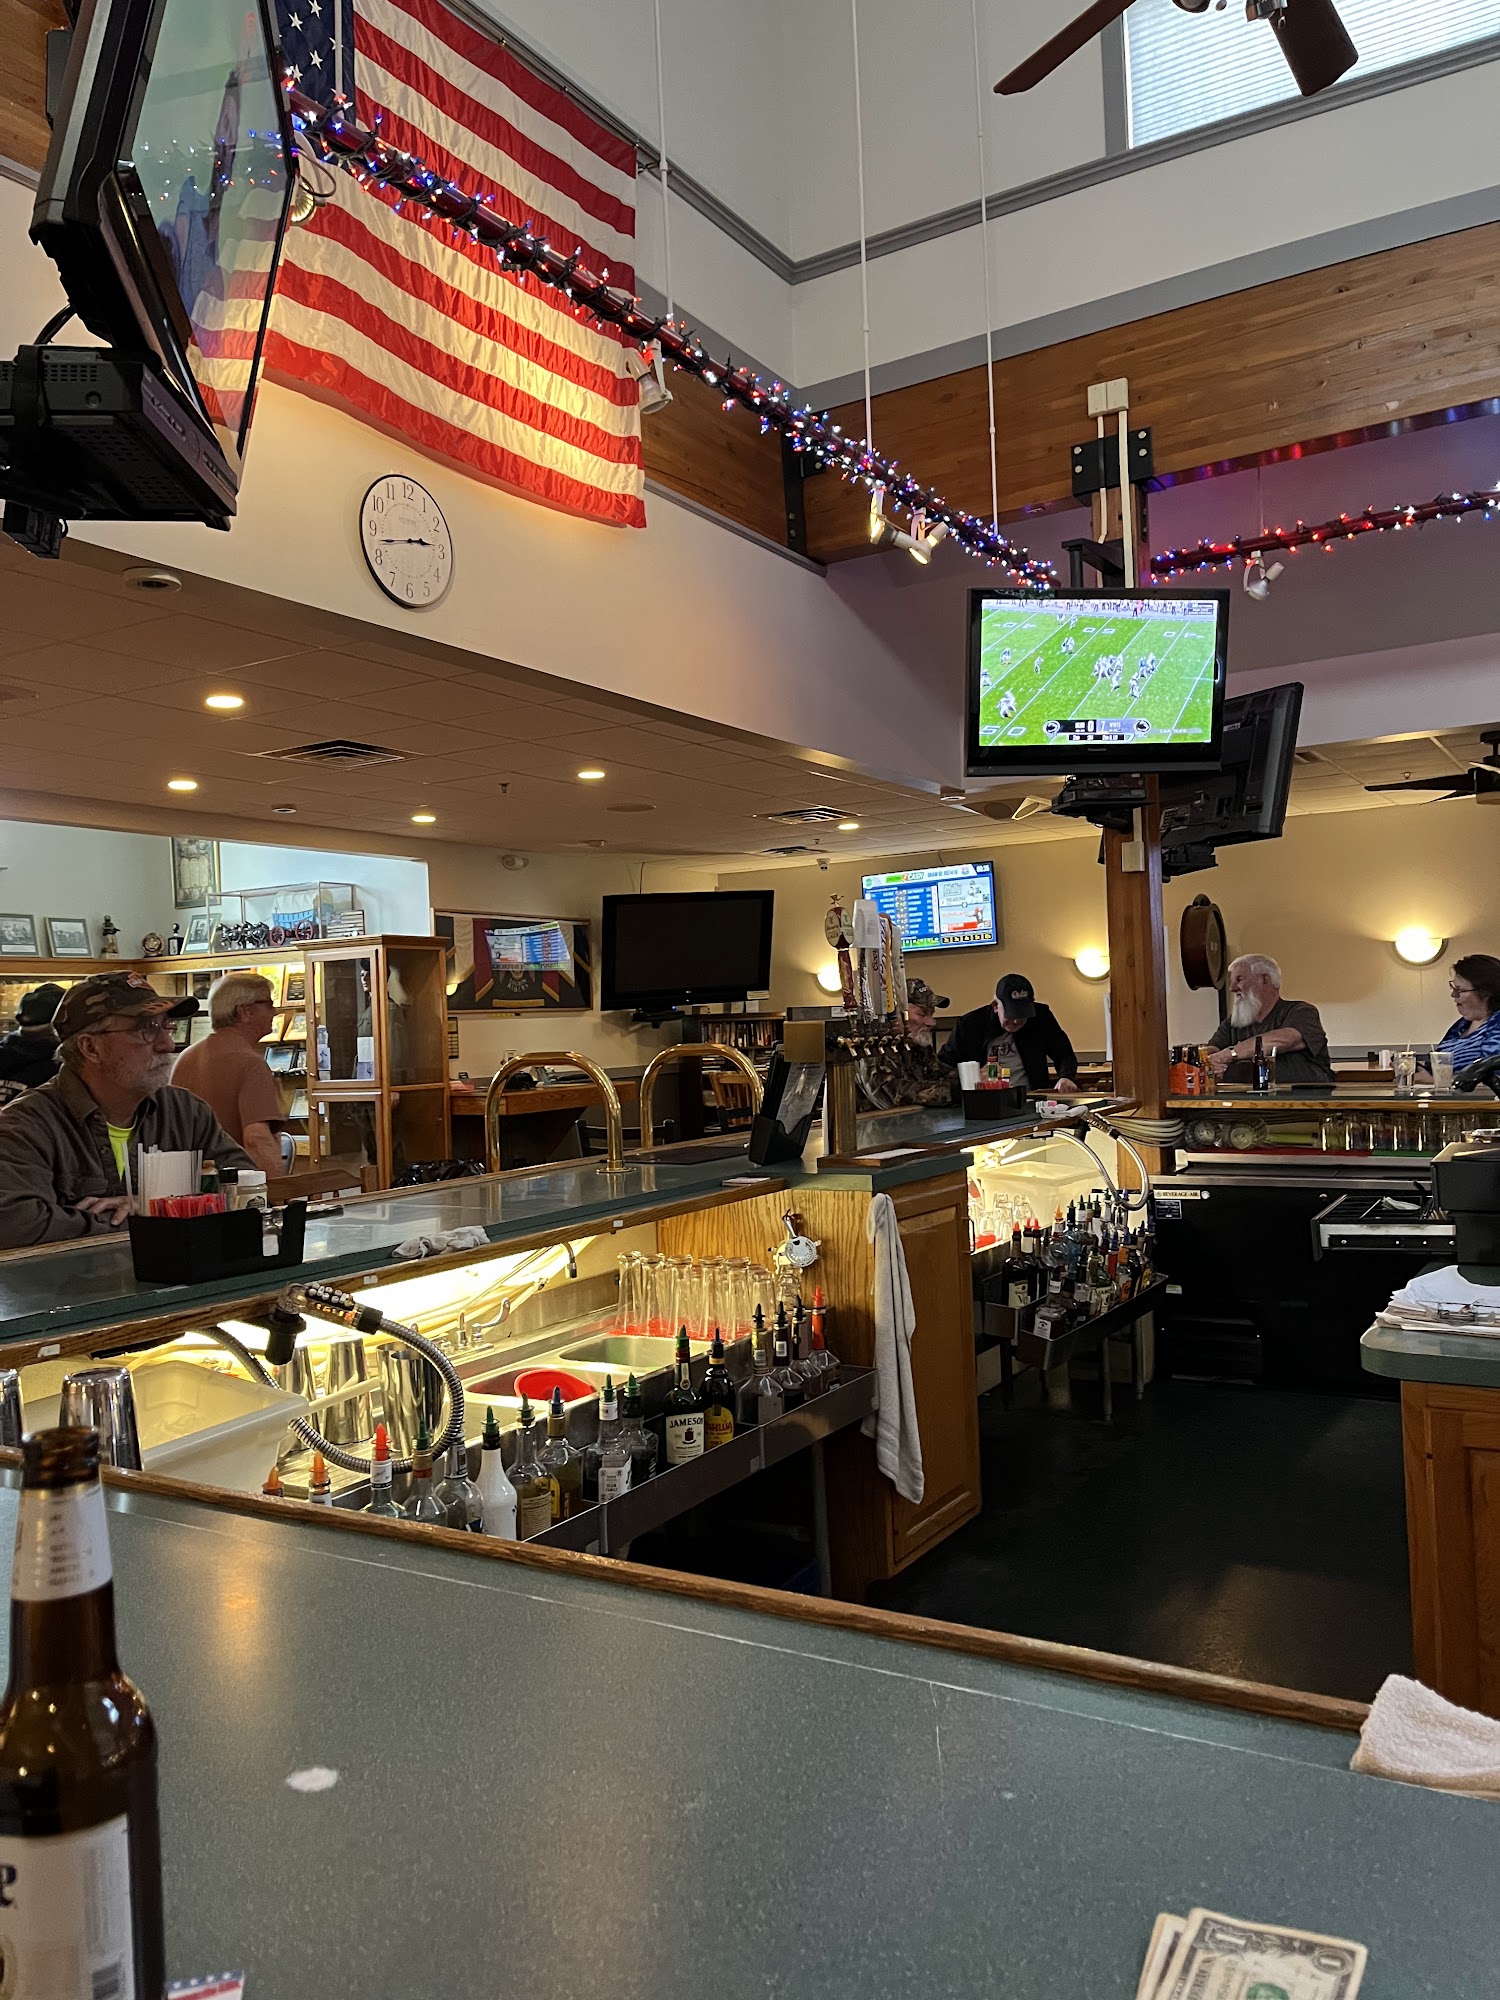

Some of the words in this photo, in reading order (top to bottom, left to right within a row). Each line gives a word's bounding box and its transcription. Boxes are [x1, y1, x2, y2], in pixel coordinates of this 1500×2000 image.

[386, 482, 395, 500] 11
[402, 482, 414, 501] 12
[372, 495, 384, 514] 10
[422, 497, 427, 513] 1
[369, 520, 377, 537] 9
[432, 516, 440, 533] 2
[375, 548, 383, 566] 8
[438, 544, 445, 560] 3
[389, 570, 396, 587] 7
[433, 567, 441, 583] 4
[406, 582, 414, 599] 6
[423, 581, 430, 597] 5
[1087, 720, 1094, 732] 0
